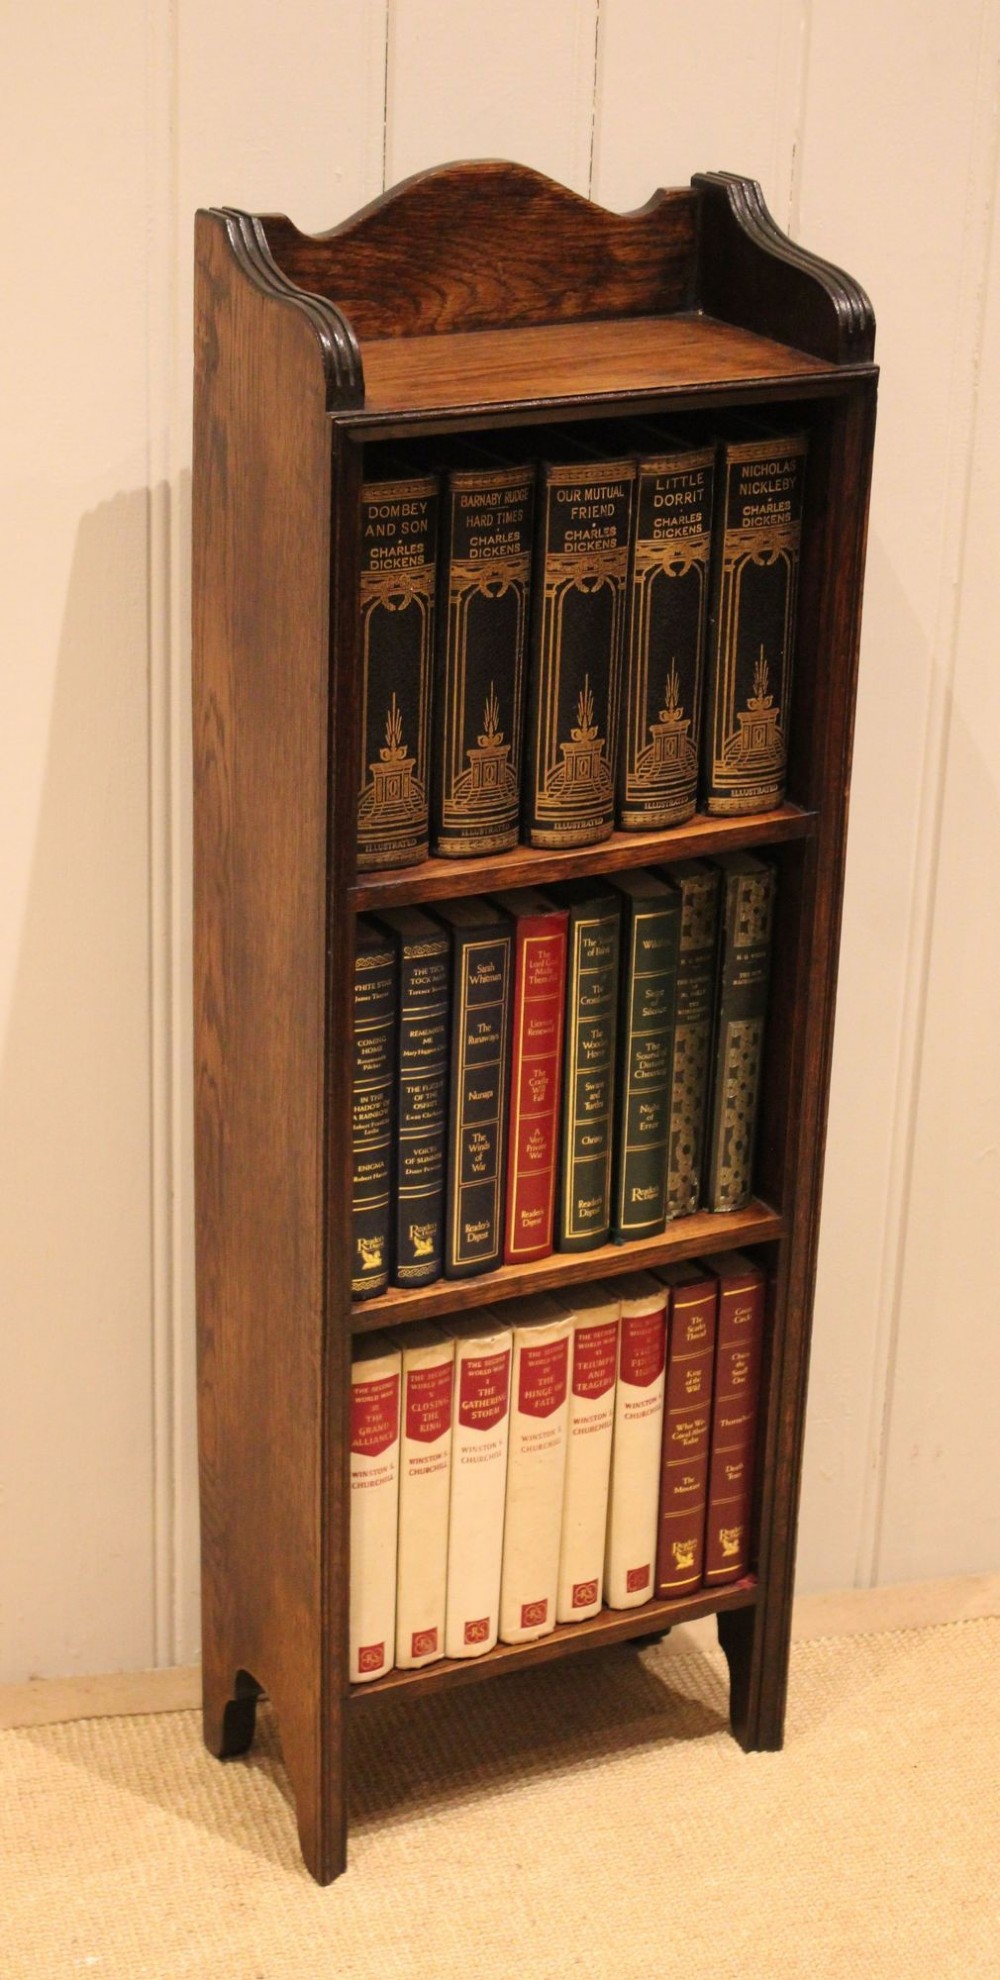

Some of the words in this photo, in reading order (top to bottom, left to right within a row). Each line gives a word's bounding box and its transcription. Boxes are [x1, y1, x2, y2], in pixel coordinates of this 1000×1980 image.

[742, 460, 796, 477] NICHOLAS
[656, 473, 703, 490] LITTLE
[740, 477, 797, 496] NICKLEBY
[461, 493, 502, 507] BARNABY
[505, 488, 528, 504] RUDGE
[557, 489, 581, 502] OUR
[585, 486, 624, 500] MUTUAL
[654, 489, 704, 507] DORRIT
[368, 502, 427, 519] DOMBEY
[571, 504, 614, 520] FRIEND
[743, 501, 791, 516] CHARLES
[467, 513, 493, 528] HARD
[497, 510, 523, 524] TIMES
[654, 513, 702, 528] CHARLES
[742, 512, 791, 527] DICKENS
[365, 524, 396, 537] AND
[401, 520, 428, 535] SON
[565, 527, 616, 541] CHARLES
[653, 524, 702, 539] DICKENS
[470, 532, 520, 546] CHARLES
[564, 538, 616, 552] DICKENS
[370, 543, 424, 558] CHARLES
[470, 543, 520, 558] DICKENS
[370, 555, 424, 570] DICKENS
[731, 784, 779, 797] ILLUSTRATED
[644, 797, 689, 810] ILLUSTRATED
[462, 823, 510, 837] ILLUSTRATED
[554, 817, 604, 830] ILLUSTRATED
[365, 838, 417, 853] ILLUSTRATED
[583, 938, 596, 947] The
[477, 962, 495, 974] Sarah
[469, 974, 501, 984] Whitman
[478, 1023, 491, 1033] The
[646, 1043, 660, 1051] The
[533, 1069, 546, 1077] The
[473, 1133, 486, 1142] The
[469, 1141, 490, 1152] Winds
[475, 1152, 482, 1162] of
[358, 1162, 384, 1172] ENIGMA
[472, 1163, 486, 1172] War
[465, 1220, 490, 1233] Reader's
[467, 1231, 488, 1243] Digest
[588, 1370, 605, 1379] AND
[538, 1377, 554, 1386] THE
[479, 1387, 495, 1397] THE
[535, 1397, 555, 1407] FATE
[626, 1398, 657, 1409] WINSTON
[423, 1412, 438, 1421] THE
[472, 1407, 500, 1419] STORM
[574, 1414, 606, 1424] WINSTON
[573, 1421, 612, 1435] CHURCHILL
[521, 1430, 555, 1441] WINSTON
[461, 1443, 496, 1453] WINSTON
[409, 1454, 442, 1464] WINSTON
[352, 1467, 388, 1478] WINSTON
